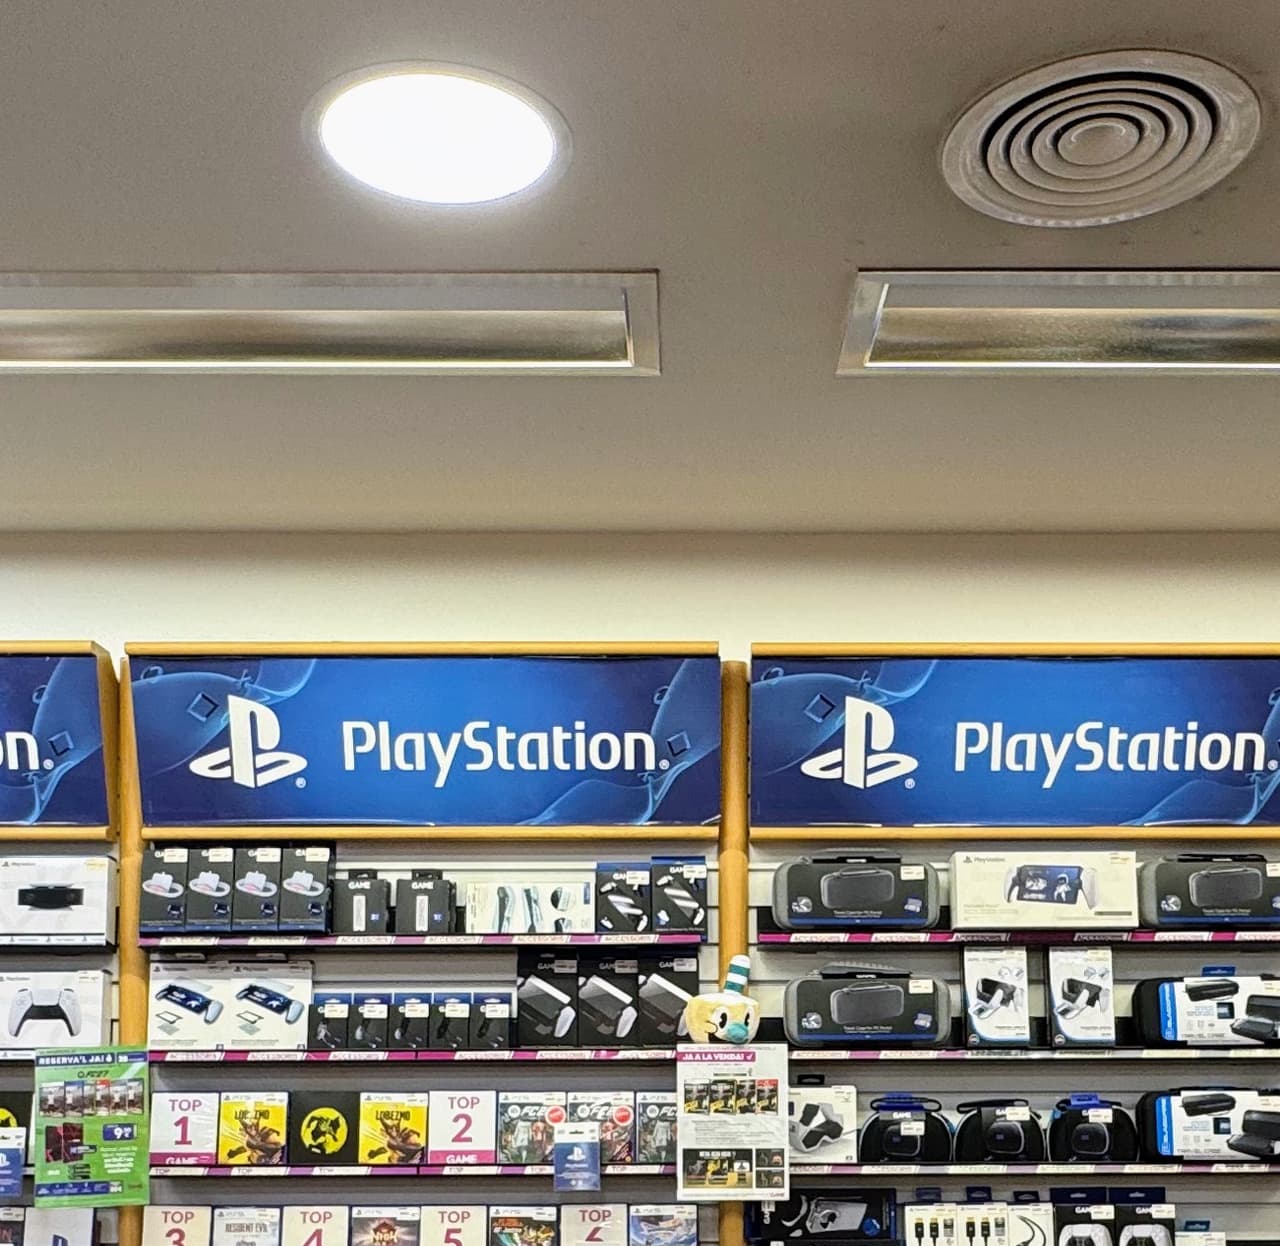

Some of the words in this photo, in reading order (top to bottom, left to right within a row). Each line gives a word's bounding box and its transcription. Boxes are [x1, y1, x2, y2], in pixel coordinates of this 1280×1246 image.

[342, 721, 655, 787] PlayStation
[955, 721, 1267, 789] PlayStation
[715, 1053, 744, 1061] VENDA!
[170, 1099, 202, 1111] TOP
[448, 1097, 480, 1109] TOP
[174, 1116, 193, 1146] 1
[451, 1113, 473, 1143] 2
[162, 1211, 194, 1224] TOP
[300, 1211, 332, 1223] TOP
